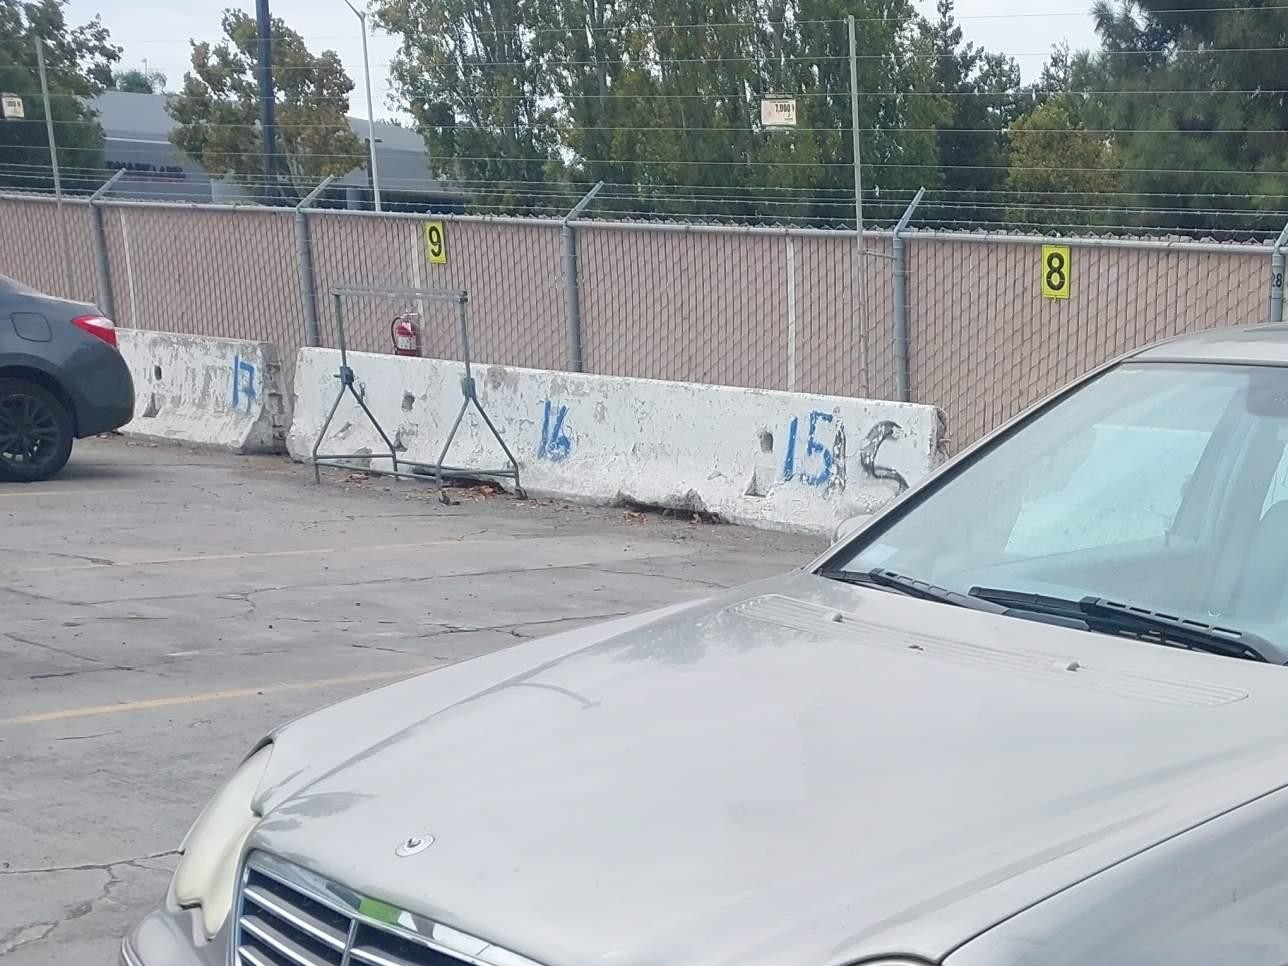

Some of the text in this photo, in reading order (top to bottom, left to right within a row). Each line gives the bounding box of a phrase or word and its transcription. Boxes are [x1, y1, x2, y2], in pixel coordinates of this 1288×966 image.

[428, 225, 442, 257] 9
[1046, 252, 1066, 291] 8
[537, 400, 571, 462] 16
[783, 410, 833, 486] 15
